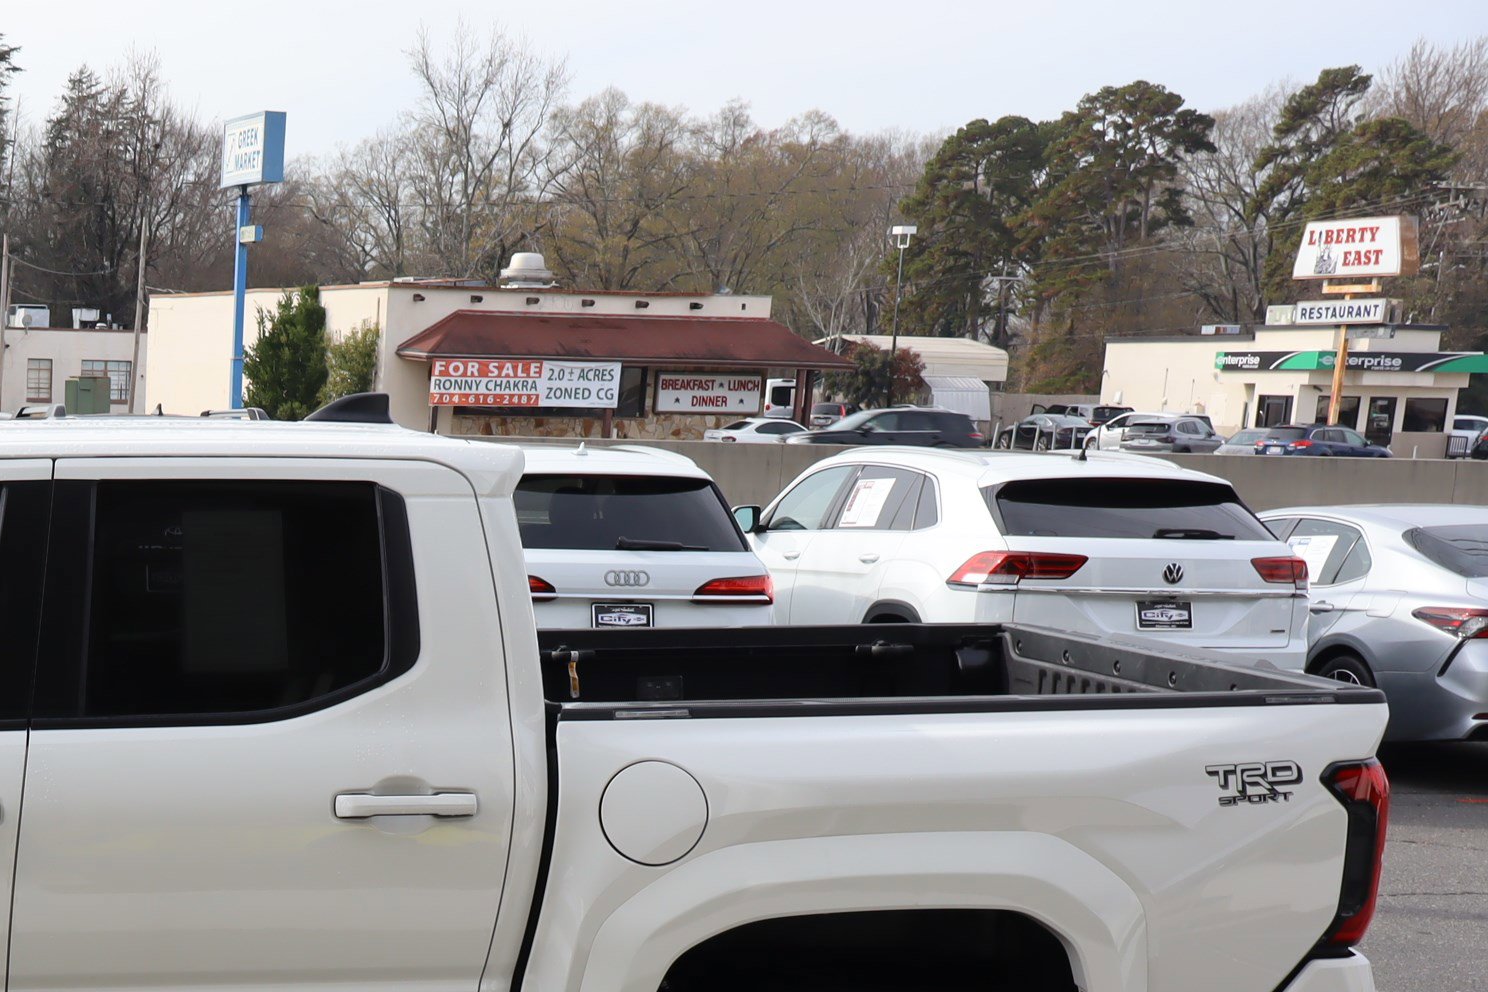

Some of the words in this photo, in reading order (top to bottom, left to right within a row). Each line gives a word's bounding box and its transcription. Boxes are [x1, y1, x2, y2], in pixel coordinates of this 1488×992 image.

[237, 127, 259, 149] GREEK
[234, 150, 261, 171] MARKET
[1342, 249, 1383, 266] EAST
[1300, 304, 1380, 320] RESTAURANT
[1216, 354, 1260, 367] enterprise
[434, 361, 479, 376] FOR
[488, 362, 541, 377] SALE
[547, 368, 564, 381] 2.0
[577, 368, 615, 382] ACRES
[434, 378, 482, 391] RONNY
[485, 379, 538, 392] CHAKRA
[661, 379, 716, 391] BREAKFAST
[727, 380, 760, 391] LUNCH
[433, 394, 537, 404] 704-616-2487
[545, 387, 591, 400] ZONED
[596, 388, 614, 400] CG
[691, 395, 728, 407] DINNER
[1205, 760, 1303, 796] TRD
[1218, 792, 1294, 807] SPORT
